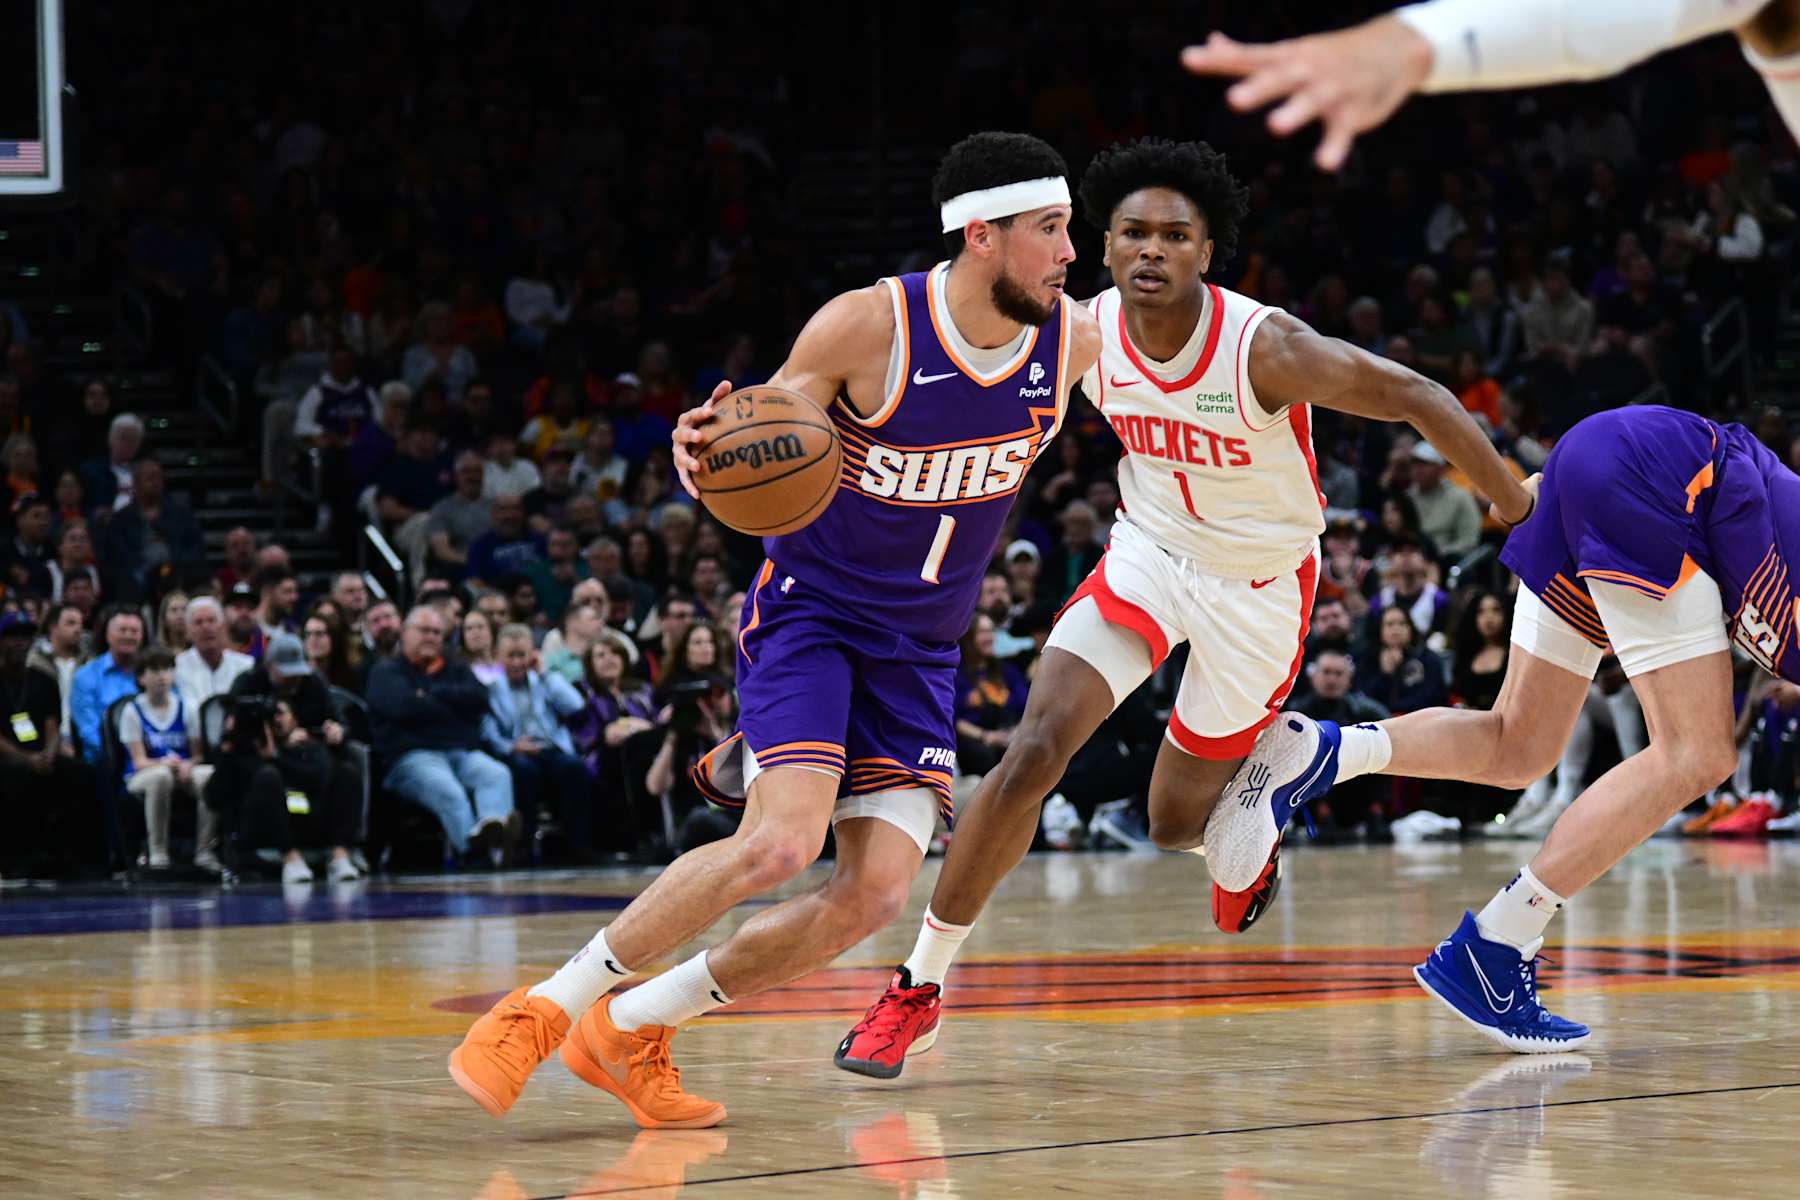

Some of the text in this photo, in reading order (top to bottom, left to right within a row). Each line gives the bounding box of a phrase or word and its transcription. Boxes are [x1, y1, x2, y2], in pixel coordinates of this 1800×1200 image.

[1019, 386, 1052, 399] PayPal
[1196, 401, 1234, 414] karma
[1197, 392, 1232, 402] credit
[705, 433, 807, 474] Wilson
[1109, 415, 1252, 467] ROCKETS
[860, 439, 1030, 501] SUNS
[1173, 471, 1204, 520] 1
[920, 513, 957, 585] 1
[917, 746, 957, 769] PHO
